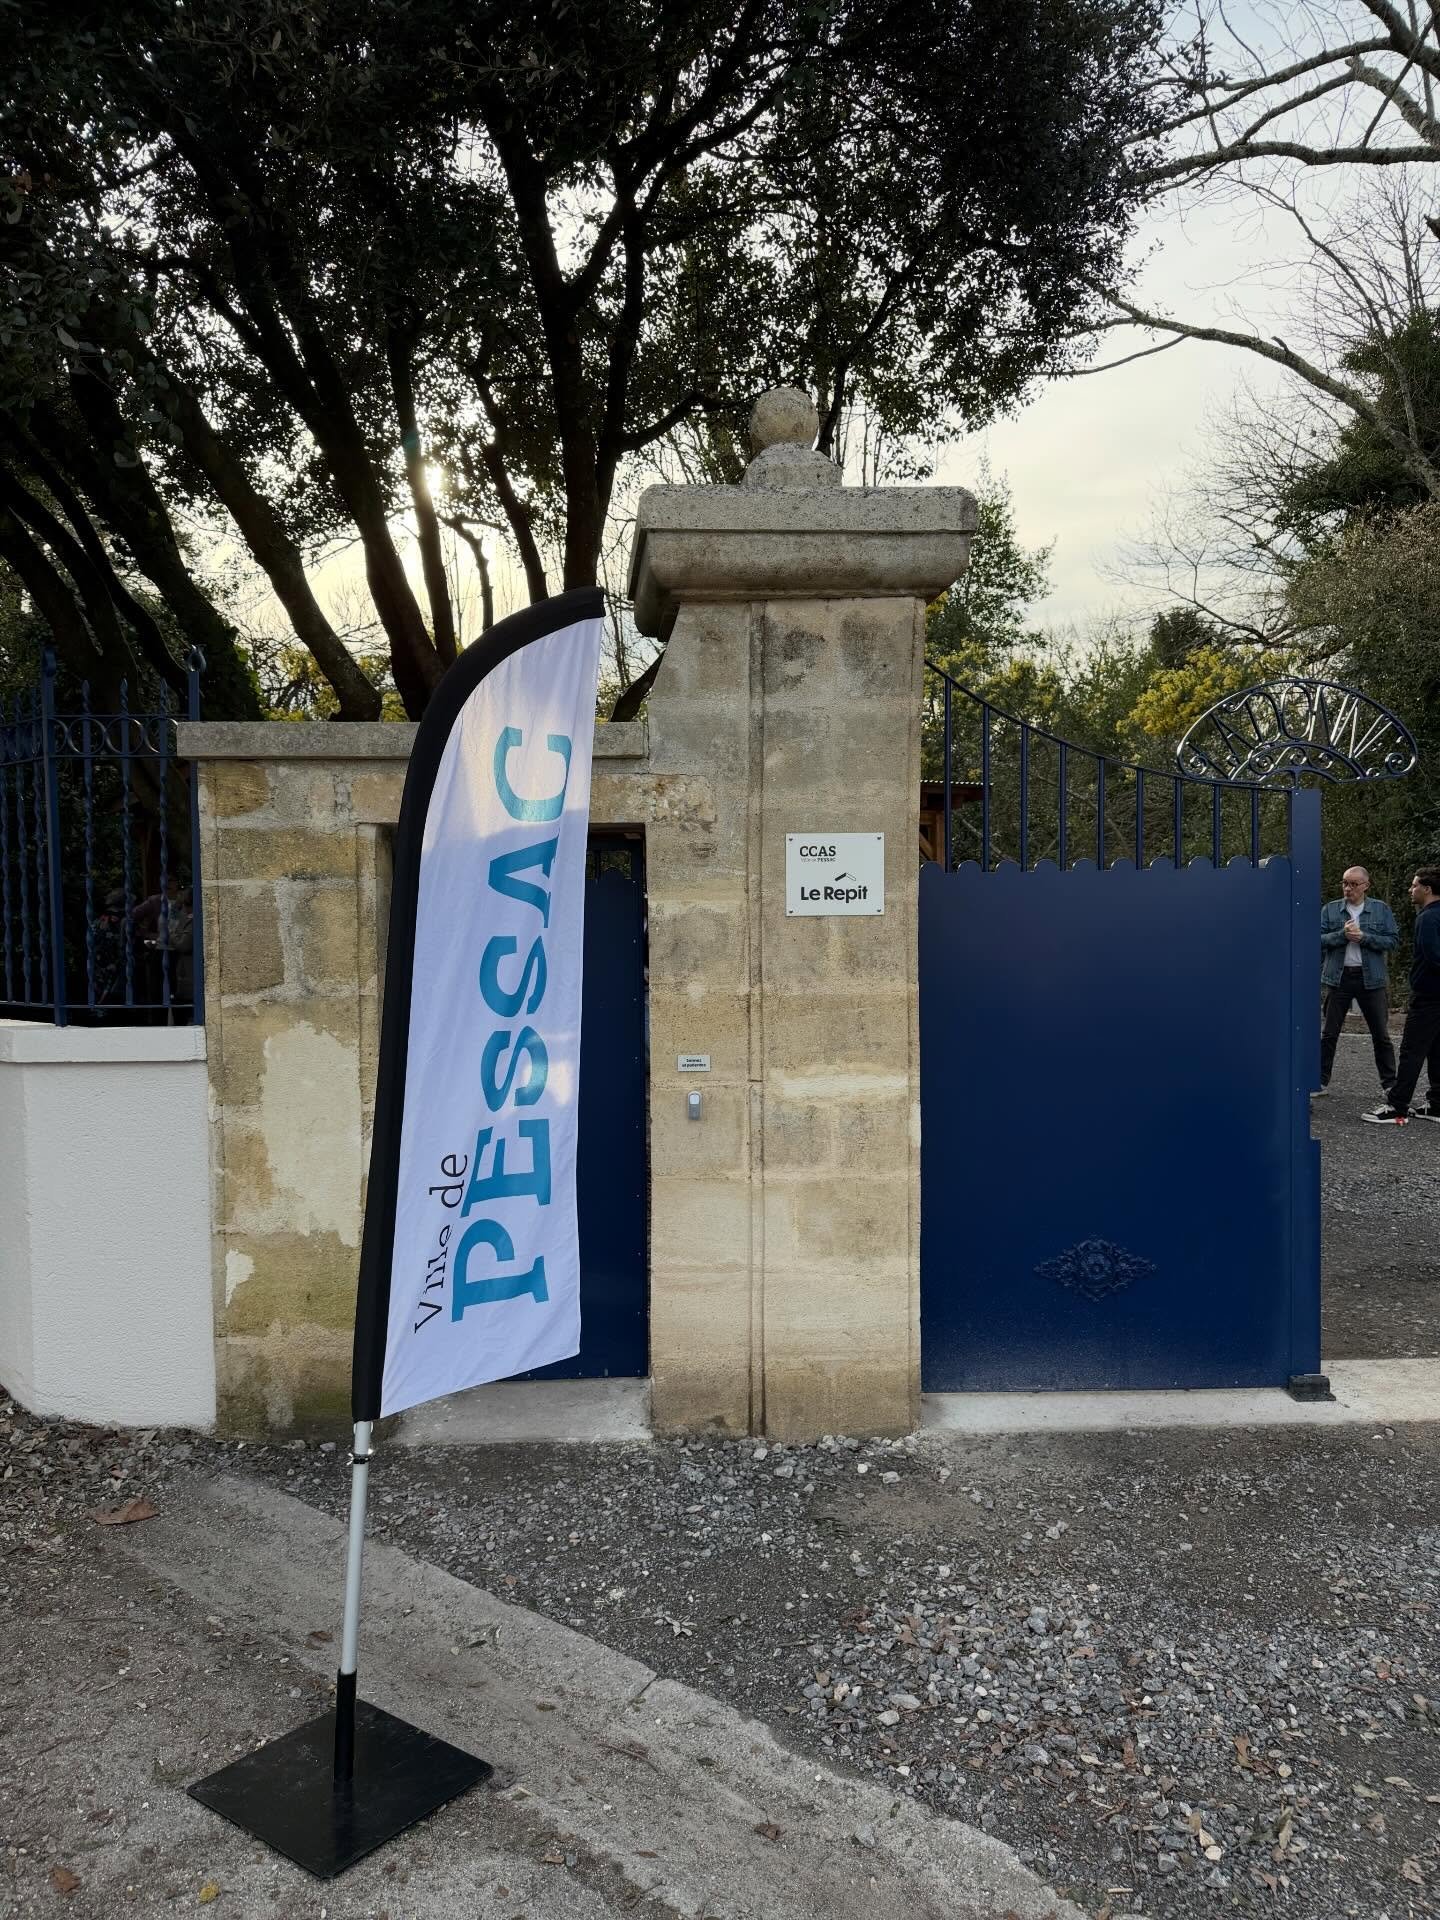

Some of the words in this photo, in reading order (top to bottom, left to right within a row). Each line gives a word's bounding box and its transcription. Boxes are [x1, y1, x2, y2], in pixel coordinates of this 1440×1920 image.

[799, 845, 836, 857] CCAS
[800, 886, 821, 901] Le
[823, 885, 868, 904] Repit
[451, 726, 573, 1323] PESSAC
[428, 1153, 468, 1209] de
[414, 1222, 453, 1334] Ville
